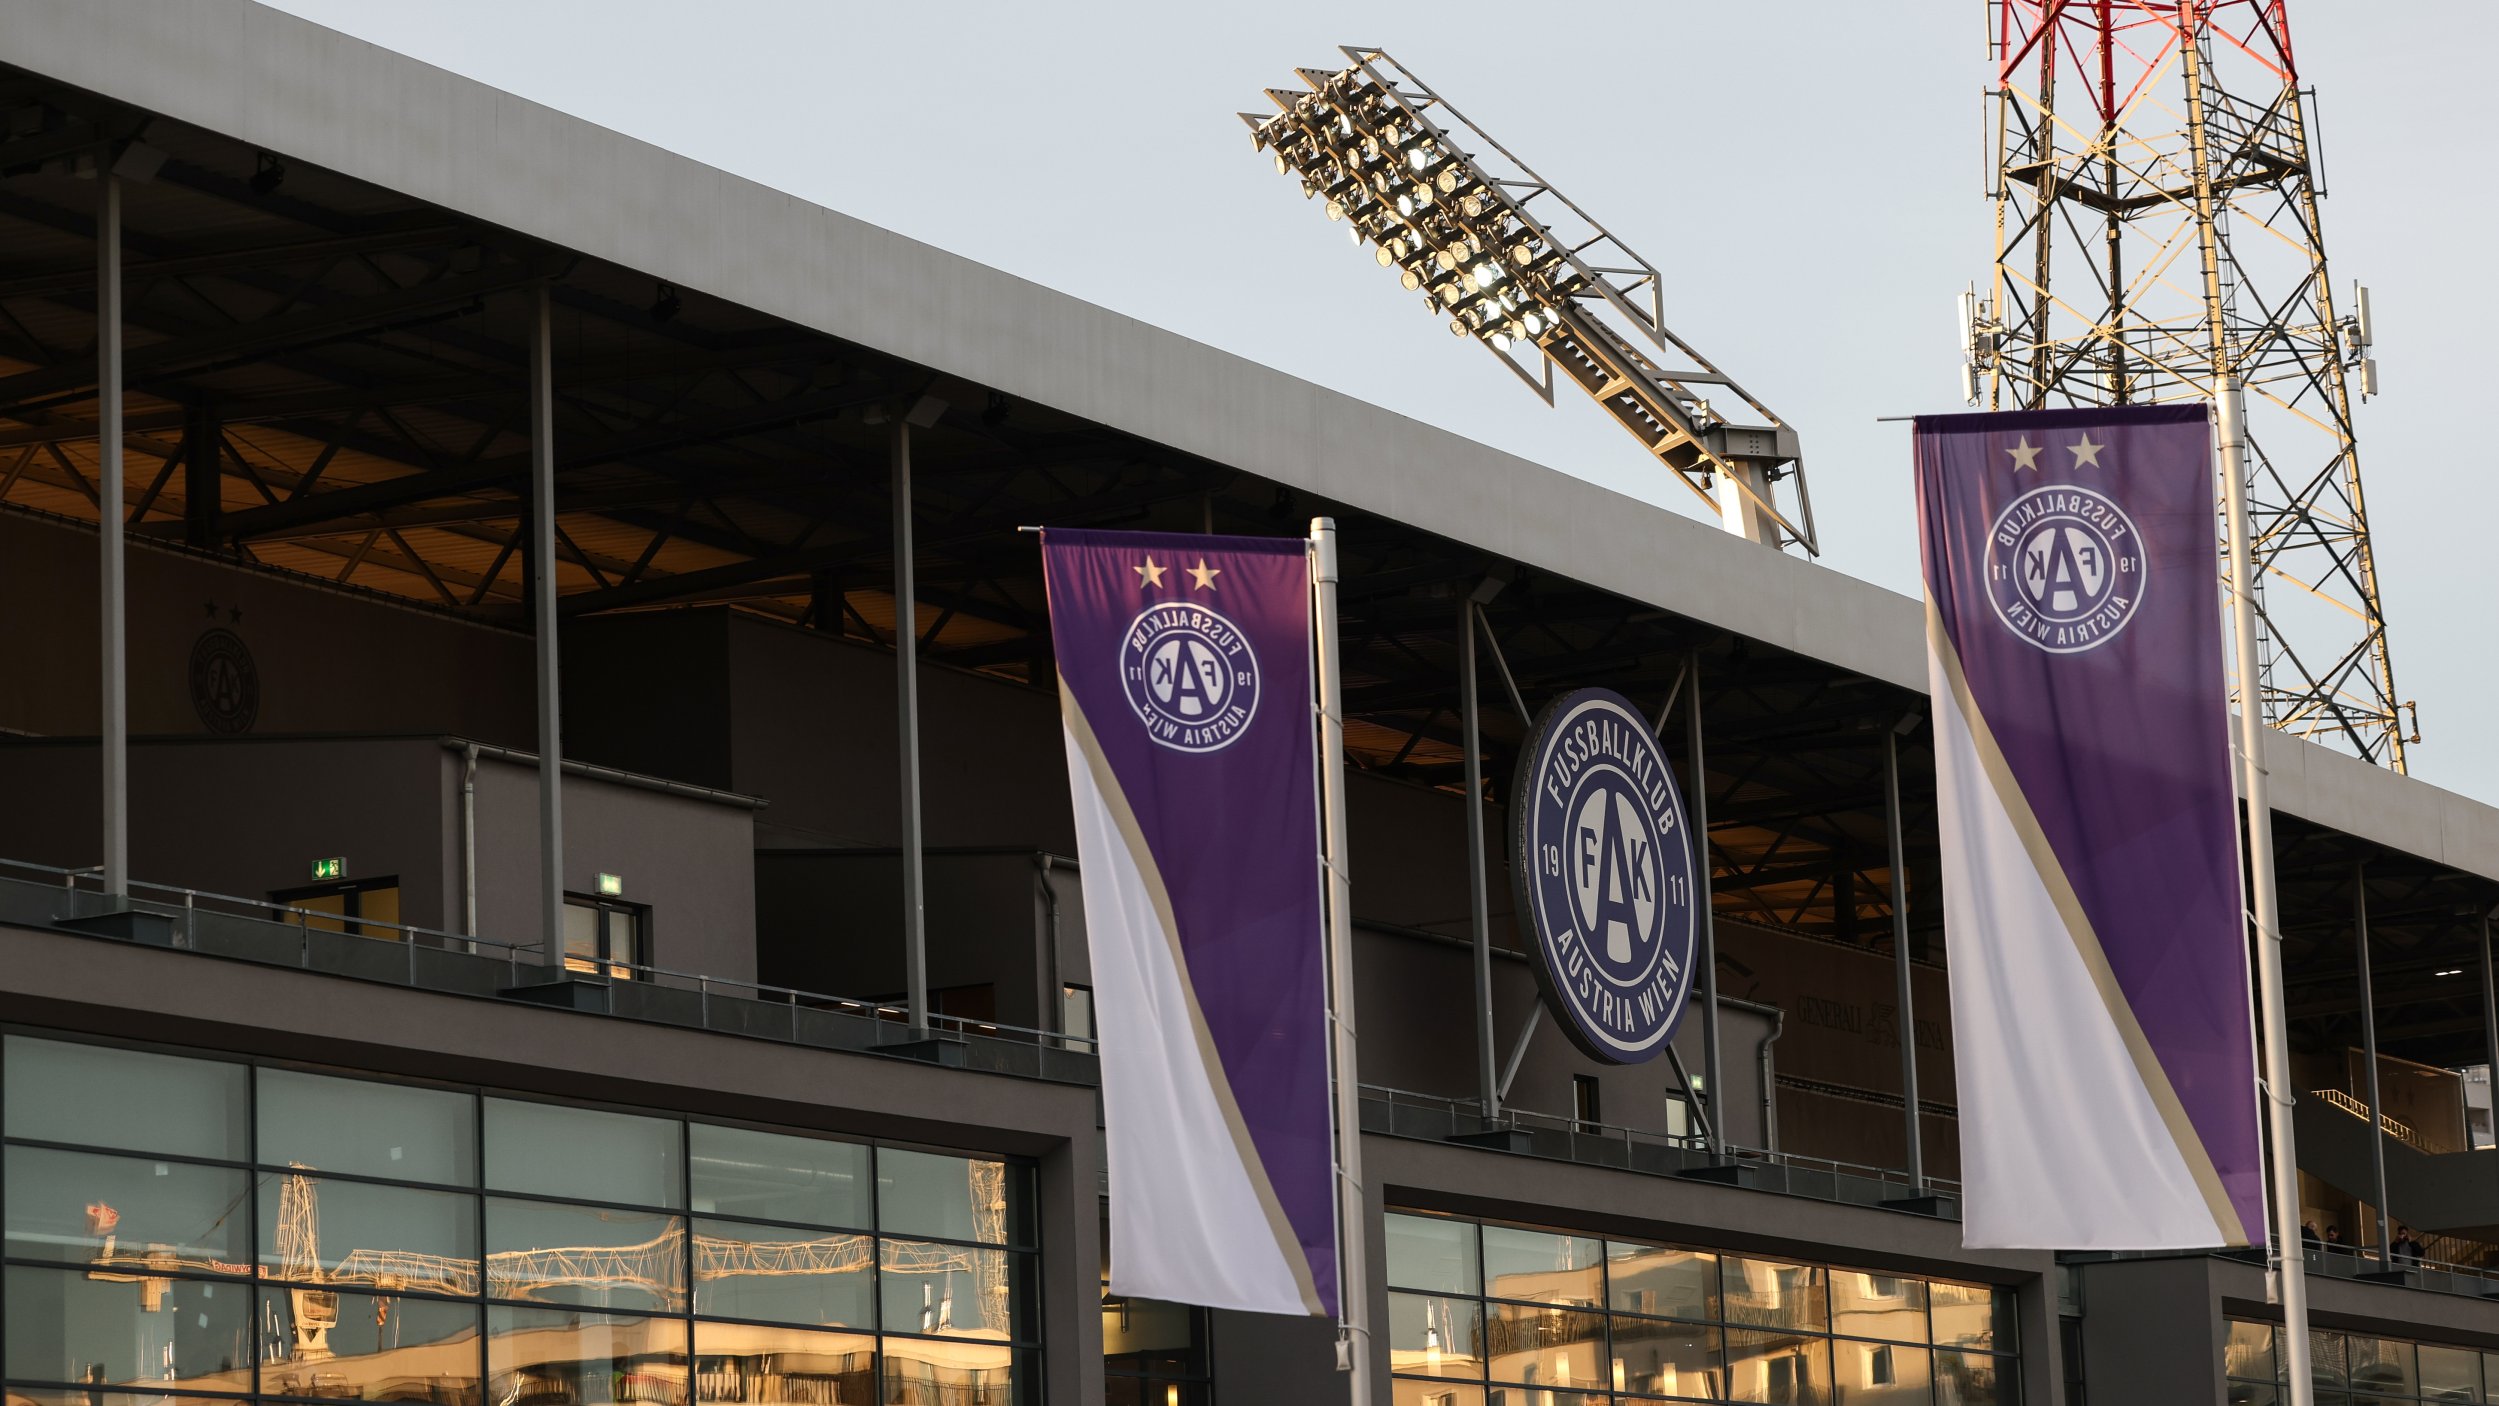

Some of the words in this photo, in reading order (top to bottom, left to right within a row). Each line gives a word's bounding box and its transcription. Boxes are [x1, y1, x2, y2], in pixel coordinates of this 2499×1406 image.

[1546, 719, 1675, 836] FUSSBALLKLUB
[1542, 843, 1560, 877] 19
[1578, 786, 1654, 964] FAK
[1670, 875, 1686, 907] 11
[1557, 928, 1635, 1033] AUSTRIA
[1638, 948, 1680, 1028] WIEN
[1797, 994, 1863, 1034] GENERALI
[1914, 1018, 1945, 1051] RENA
